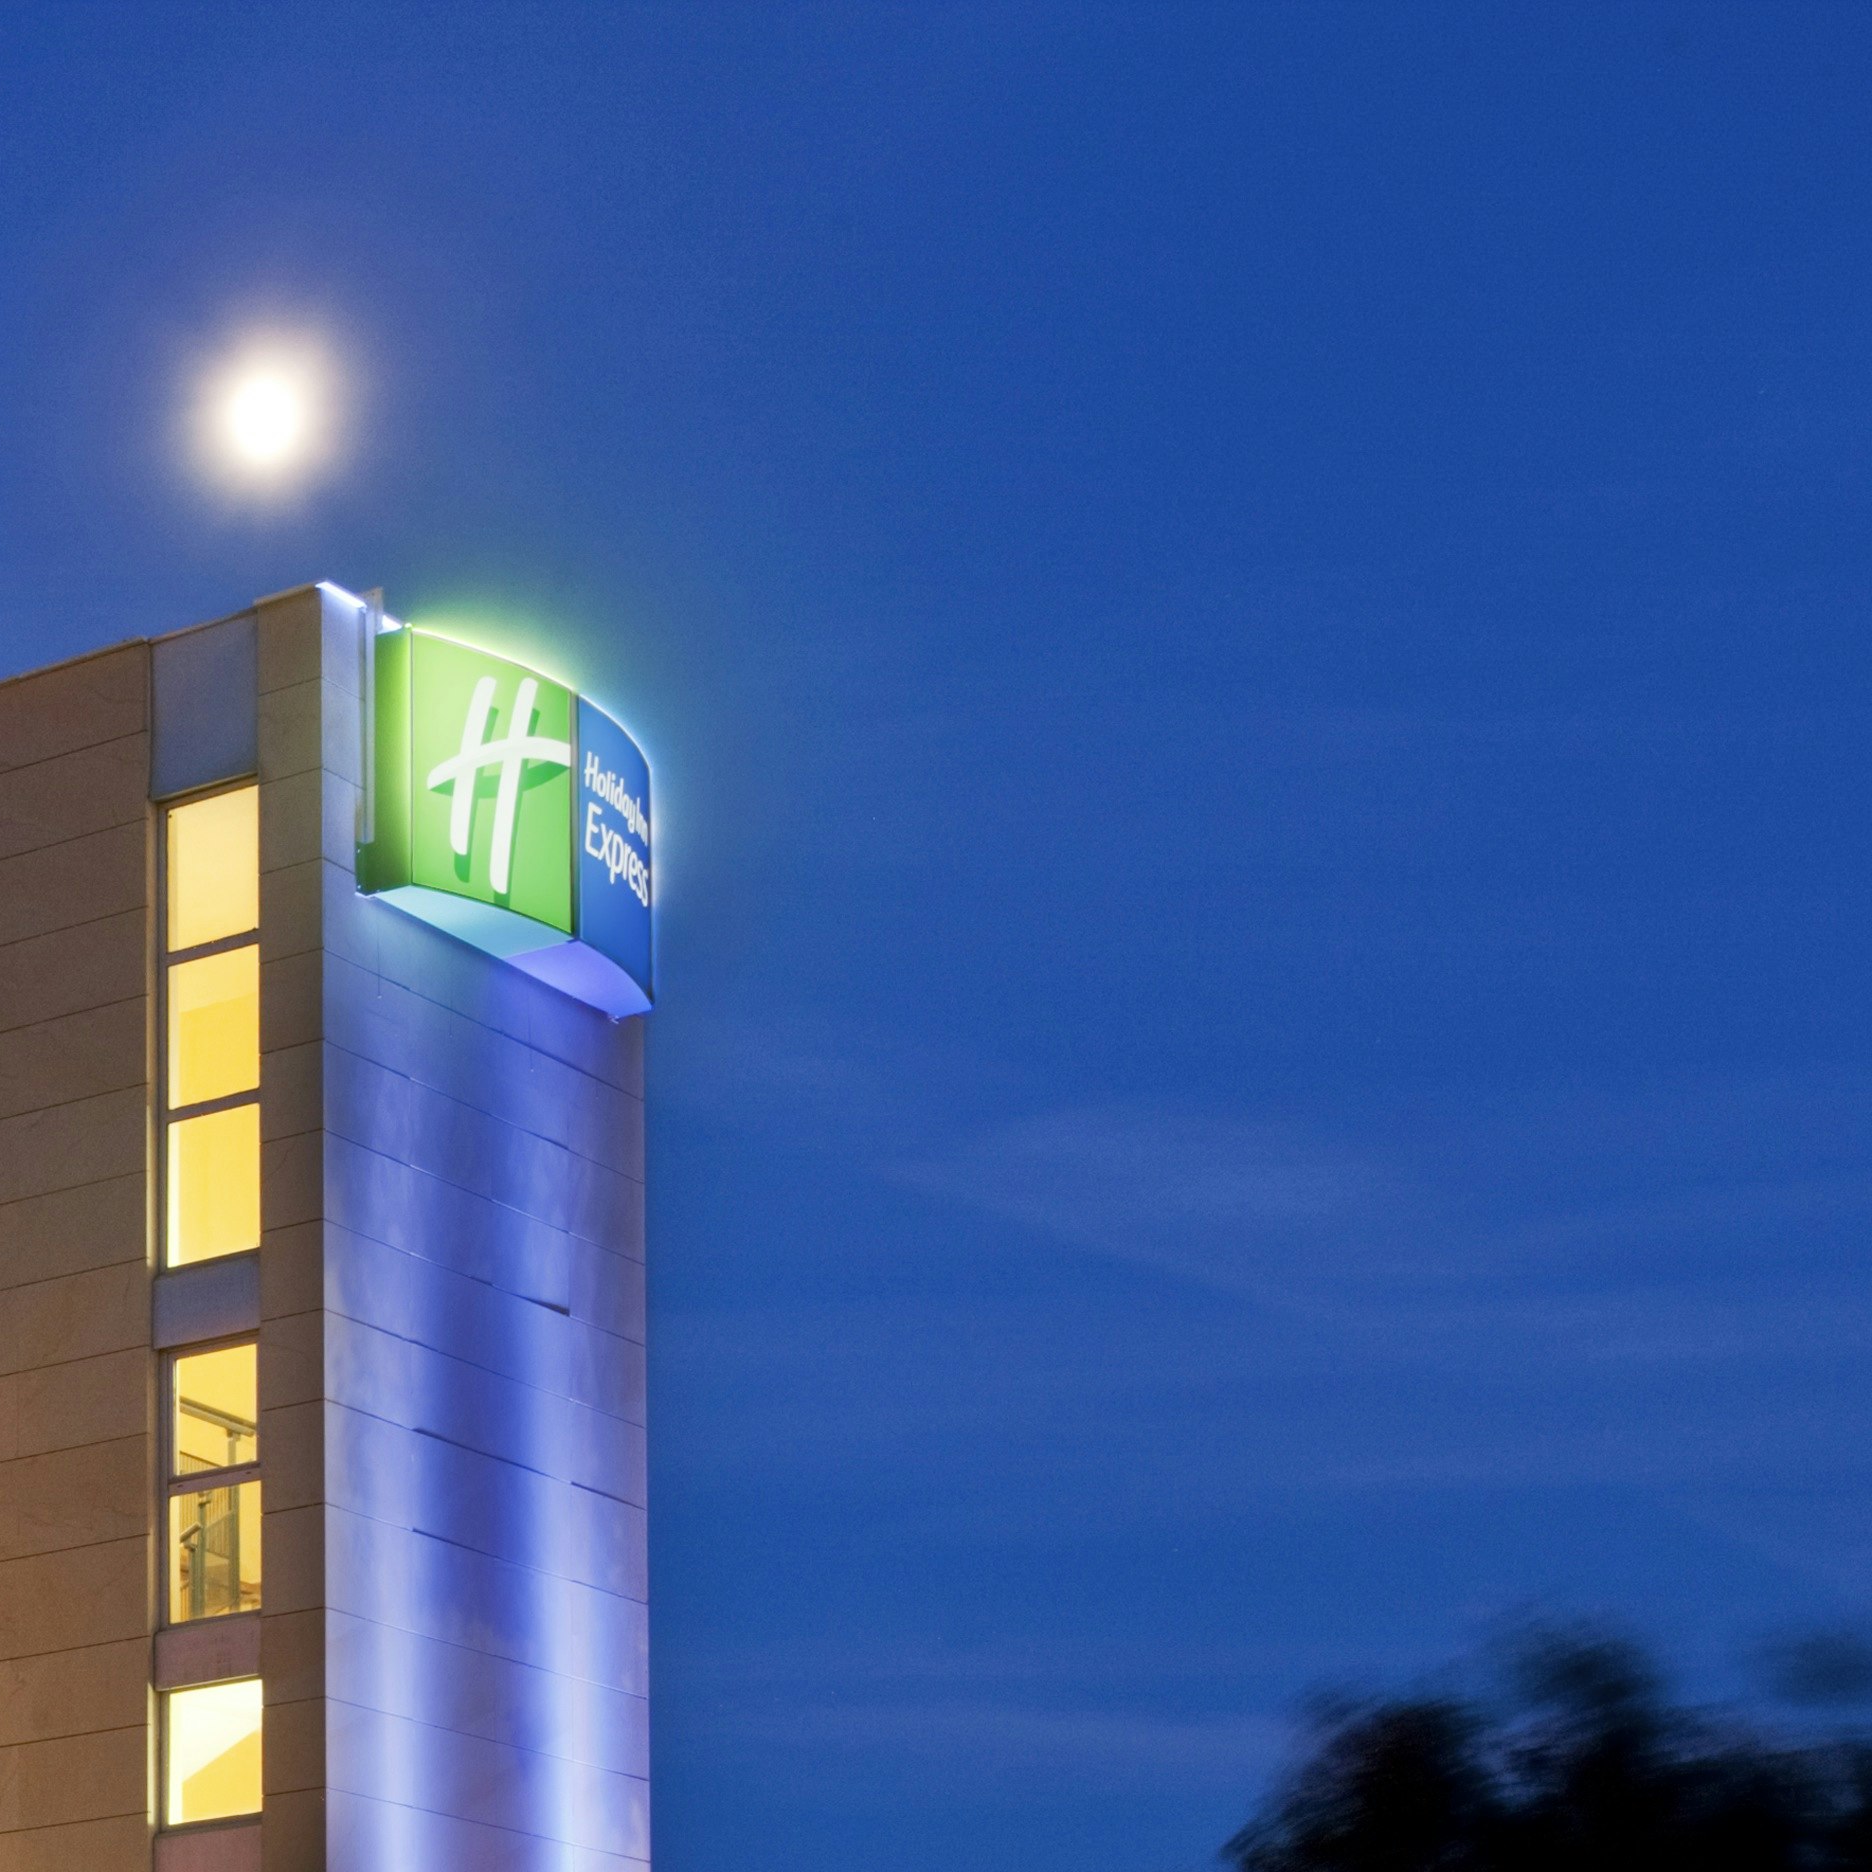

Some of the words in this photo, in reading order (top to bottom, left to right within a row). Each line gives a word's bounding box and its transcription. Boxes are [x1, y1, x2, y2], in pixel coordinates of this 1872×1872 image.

[584, 751, 635, 834] Holiday
[635, 797, 648, 847] Inn
[585, 802, 648, 907] Express
